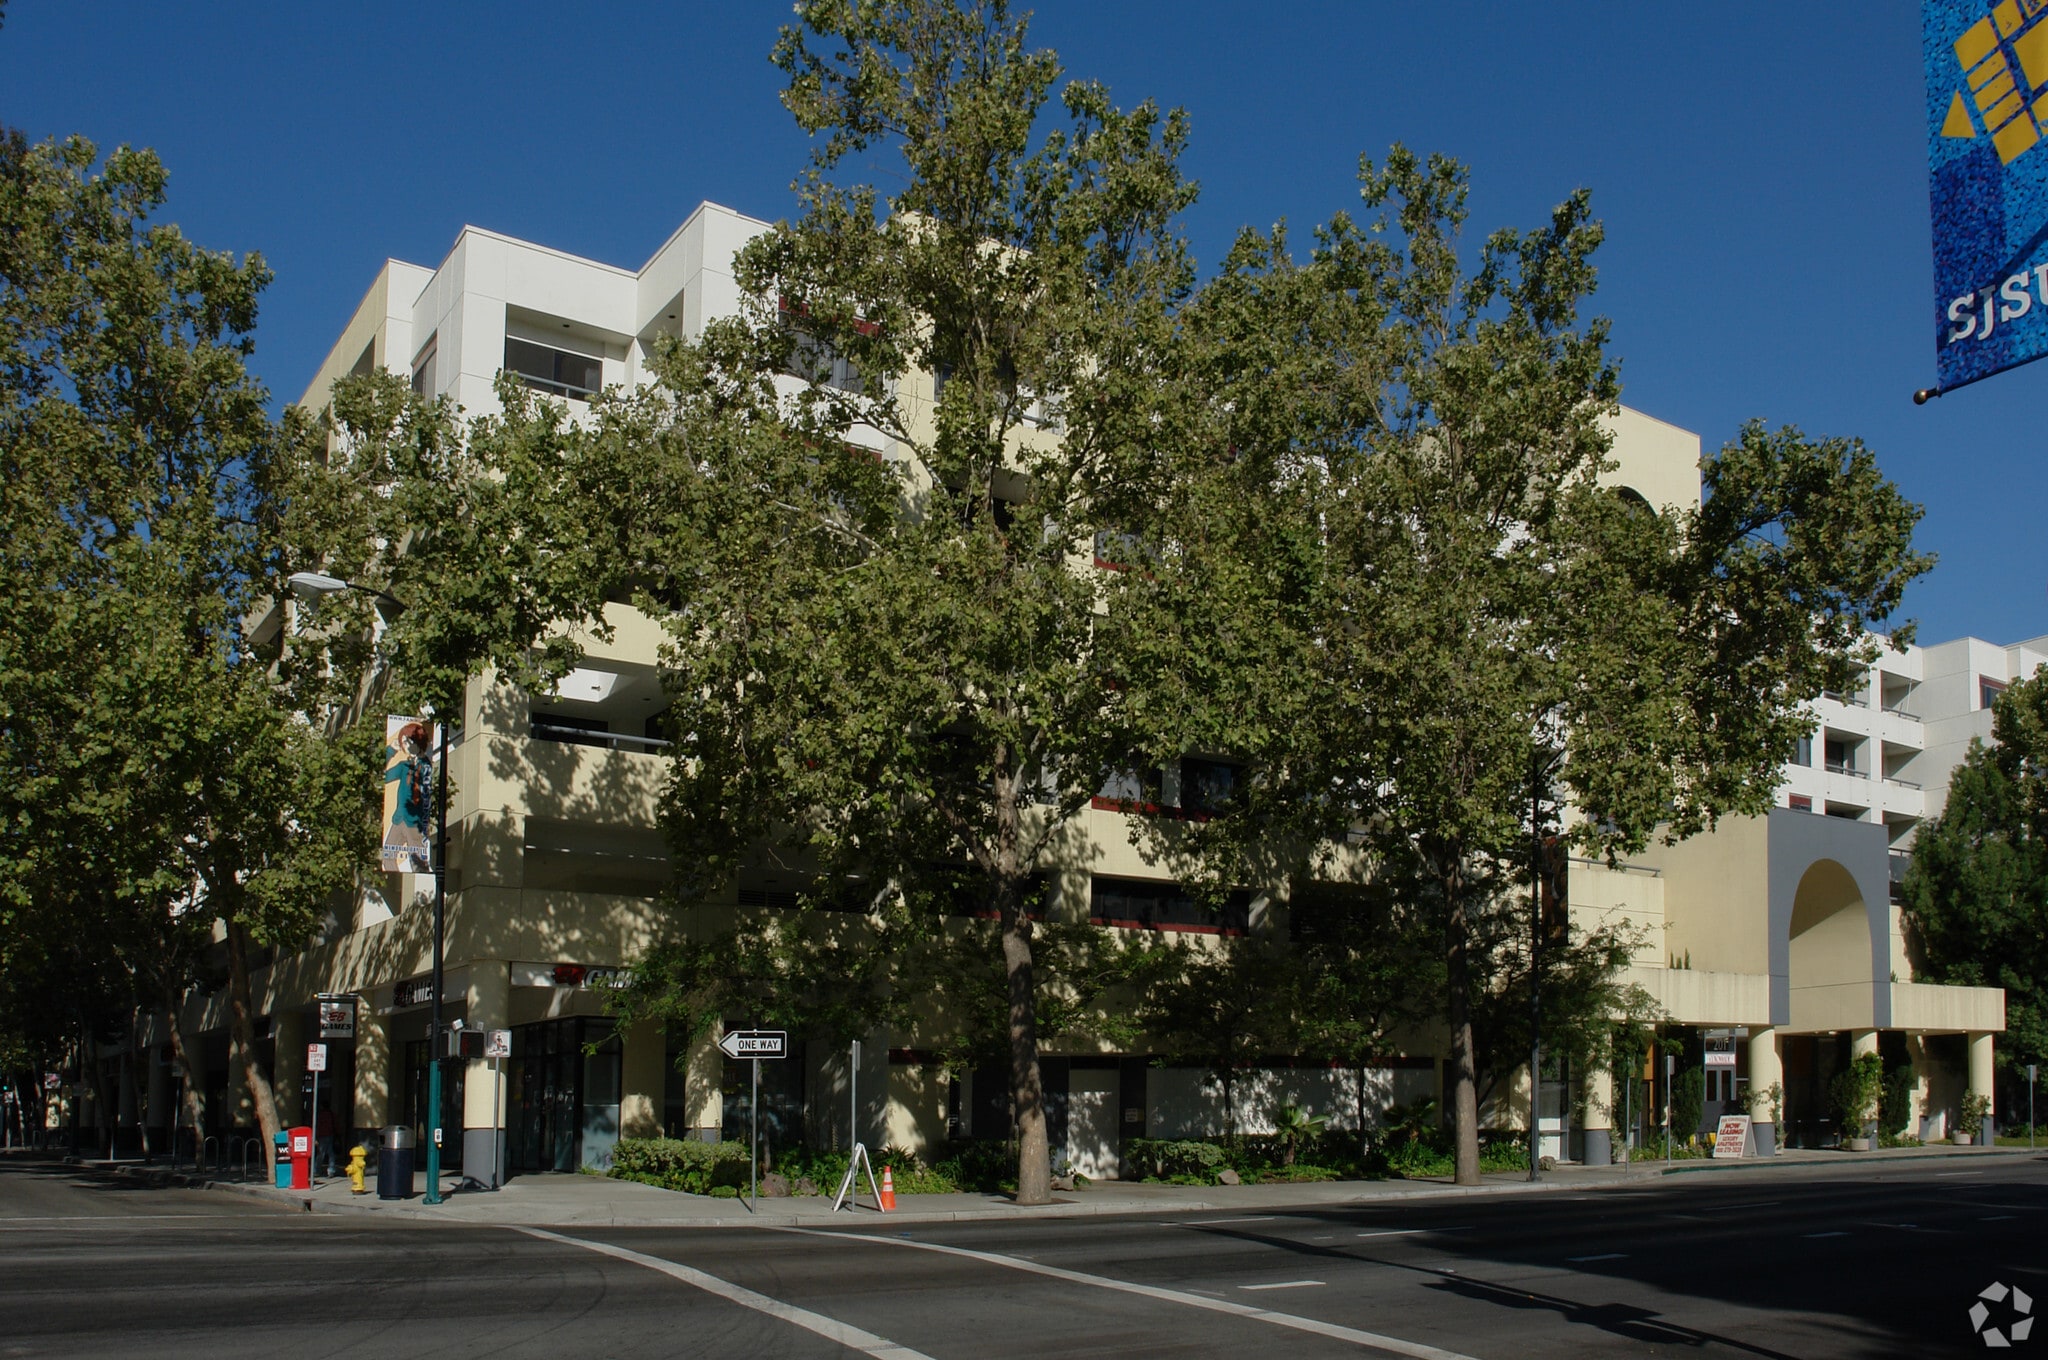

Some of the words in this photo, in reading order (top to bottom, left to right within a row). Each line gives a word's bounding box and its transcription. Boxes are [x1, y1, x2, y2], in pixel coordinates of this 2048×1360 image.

[328, 1011, 346, 1021] EB
[738, 1040, 757, 1049] ONE
[760, 1040, 778, 1049] WAY
